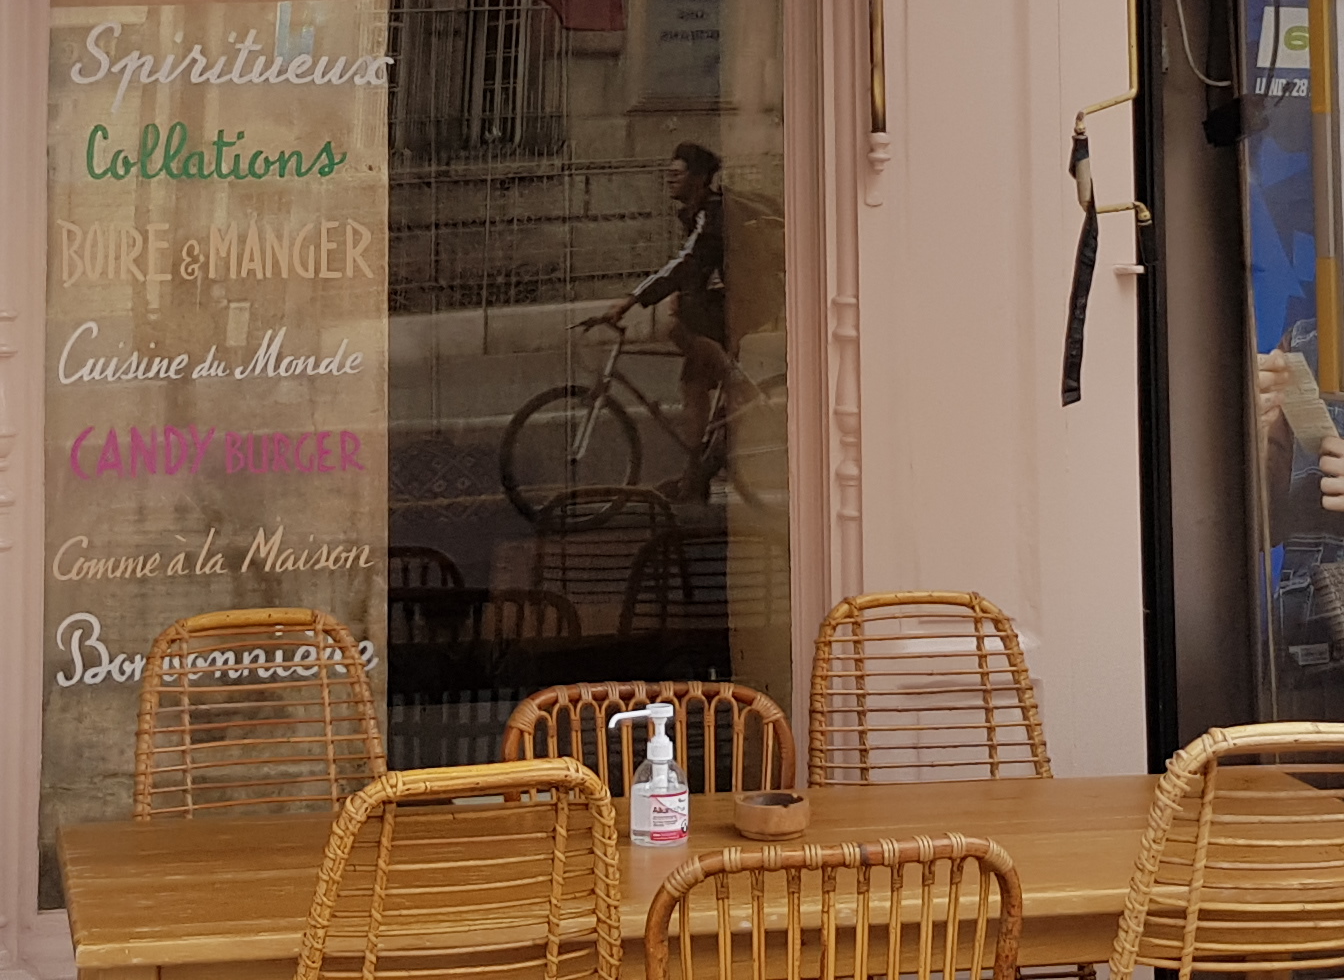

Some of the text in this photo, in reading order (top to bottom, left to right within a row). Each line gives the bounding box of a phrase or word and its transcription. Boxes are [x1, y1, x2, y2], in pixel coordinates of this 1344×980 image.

[69, 20, 396, 114] Spiritueux
[86, 121, 348, 181] Collations
[57, 220, 374, 288] BOIRE & MANGER
[57, 320, 366, 385] Cuisine du Monde
[70, 423, 367, 481] CANDY BURGER
[52, 523, 376, 582] Comme à la Maison
